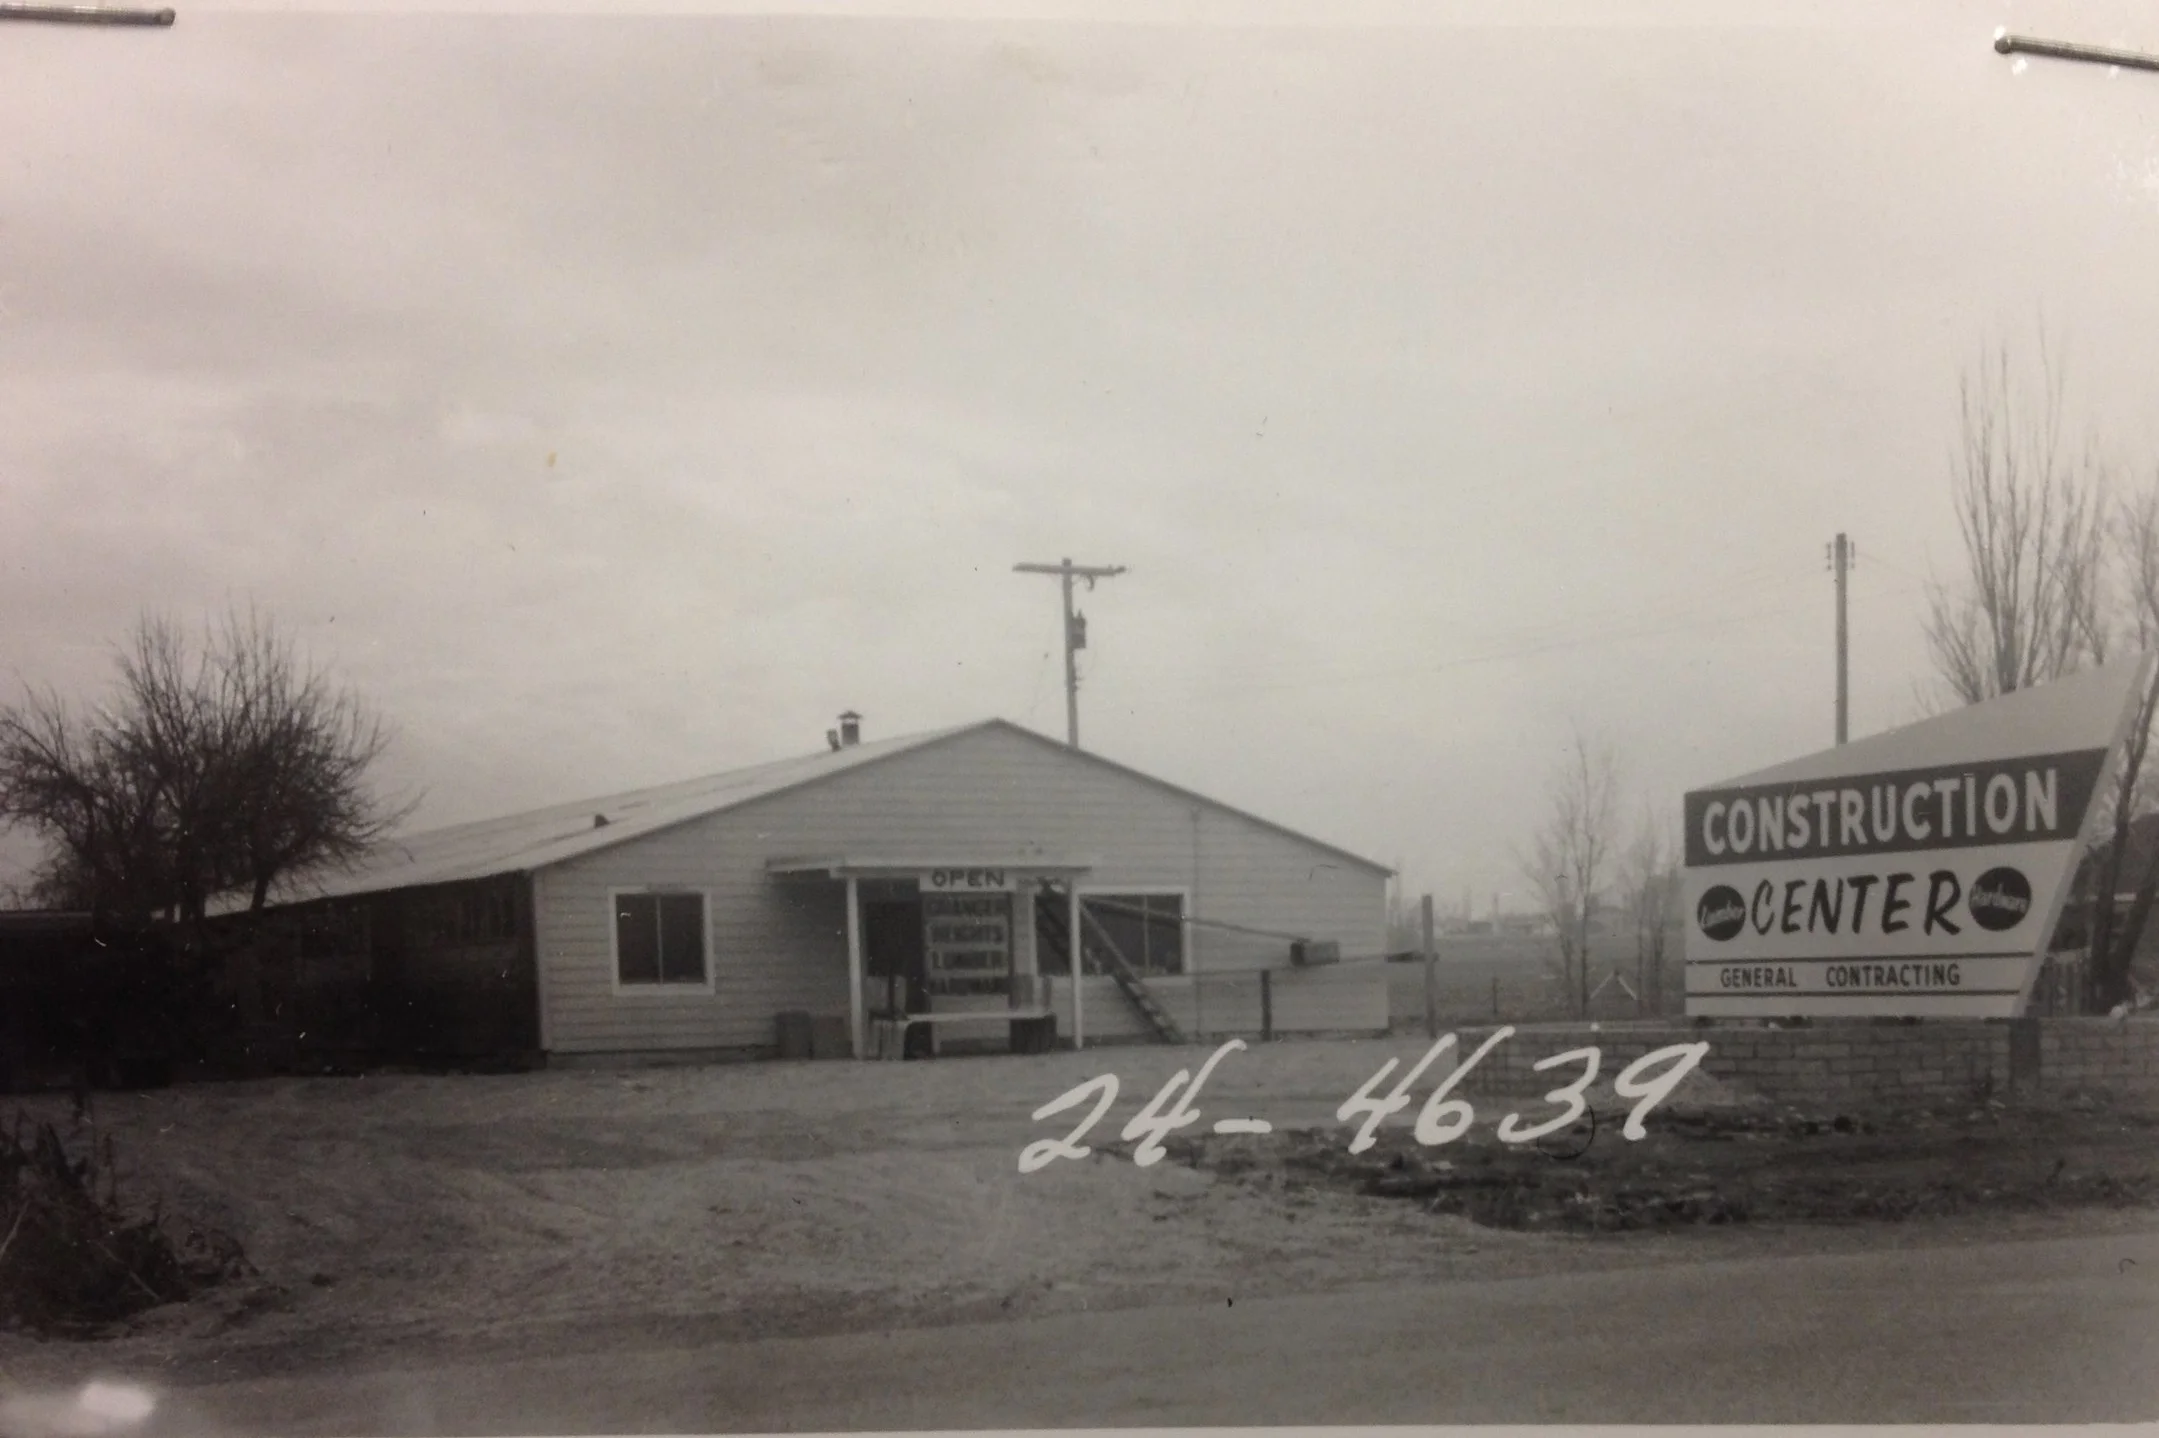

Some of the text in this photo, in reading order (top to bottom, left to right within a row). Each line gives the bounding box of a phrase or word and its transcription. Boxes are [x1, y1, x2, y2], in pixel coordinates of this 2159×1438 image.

[1703, 768, 2059, 855] CONSTRUCTION
[931, 867, 1005, 888] OPEN
[1751, 869, 1962, 936] CENTER
[1720, 963, 1960, 988] GENERAL CONTRACTING
